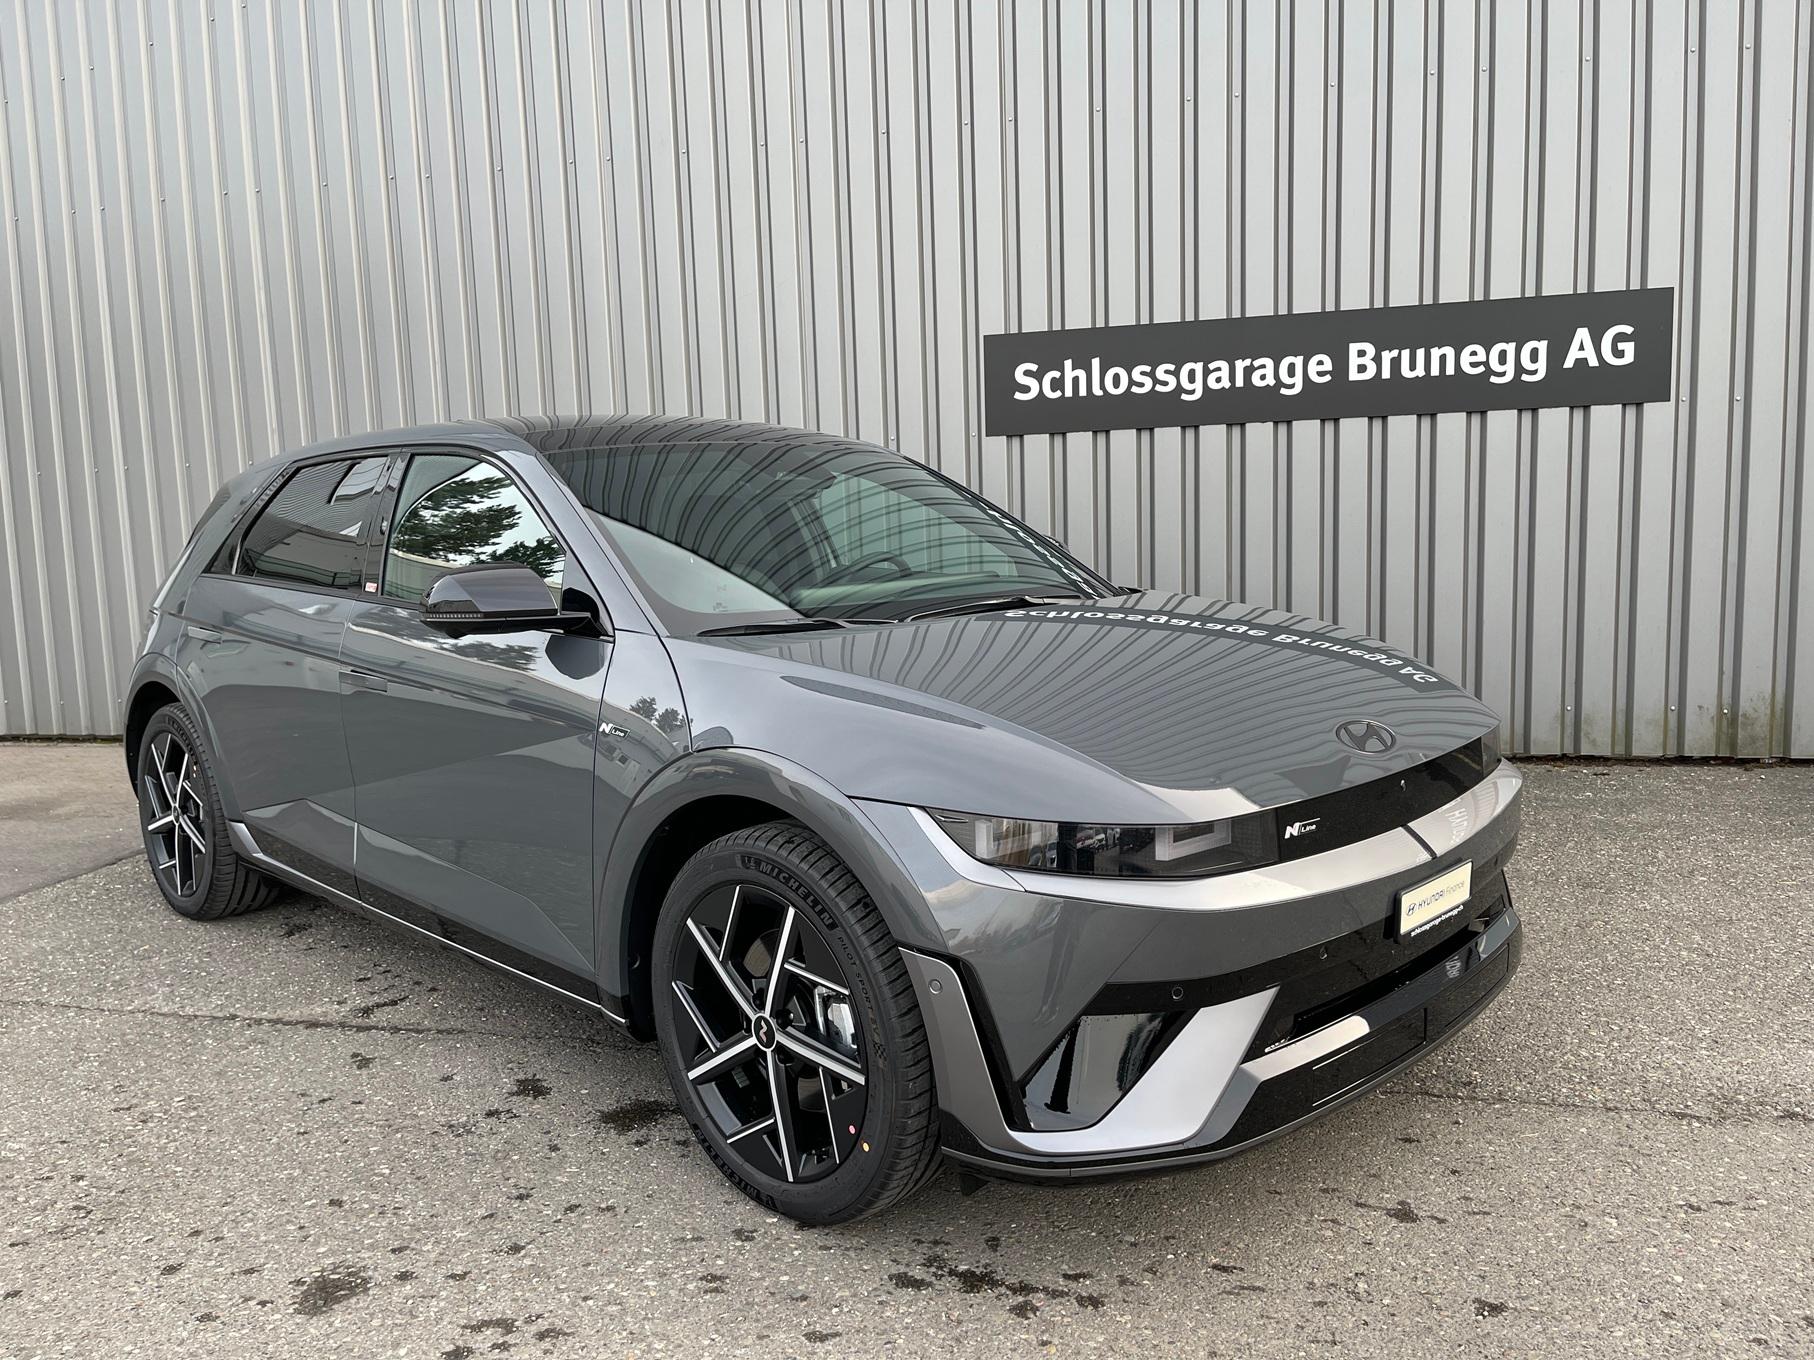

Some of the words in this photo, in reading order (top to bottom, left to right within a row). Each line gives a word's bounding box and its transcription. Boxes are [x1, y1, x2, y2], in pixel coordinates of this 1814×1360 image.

[1013, 353, 1333, 402] Schlossgarage
[1348, 339, 1549, 384] Brunegg
[1562, 324, 1636, 369] AG
[599, 722, 613, 734] N
[611, 729, 625, 737] Line
[1284, 822, 1300, 839] N
[1301, 824, 1317, 833] Line
[760, 861, 834, 926] MICHELIN
[838, 936, 857, 966] PILOT
[855, 972, 874, 1010] SPORT
